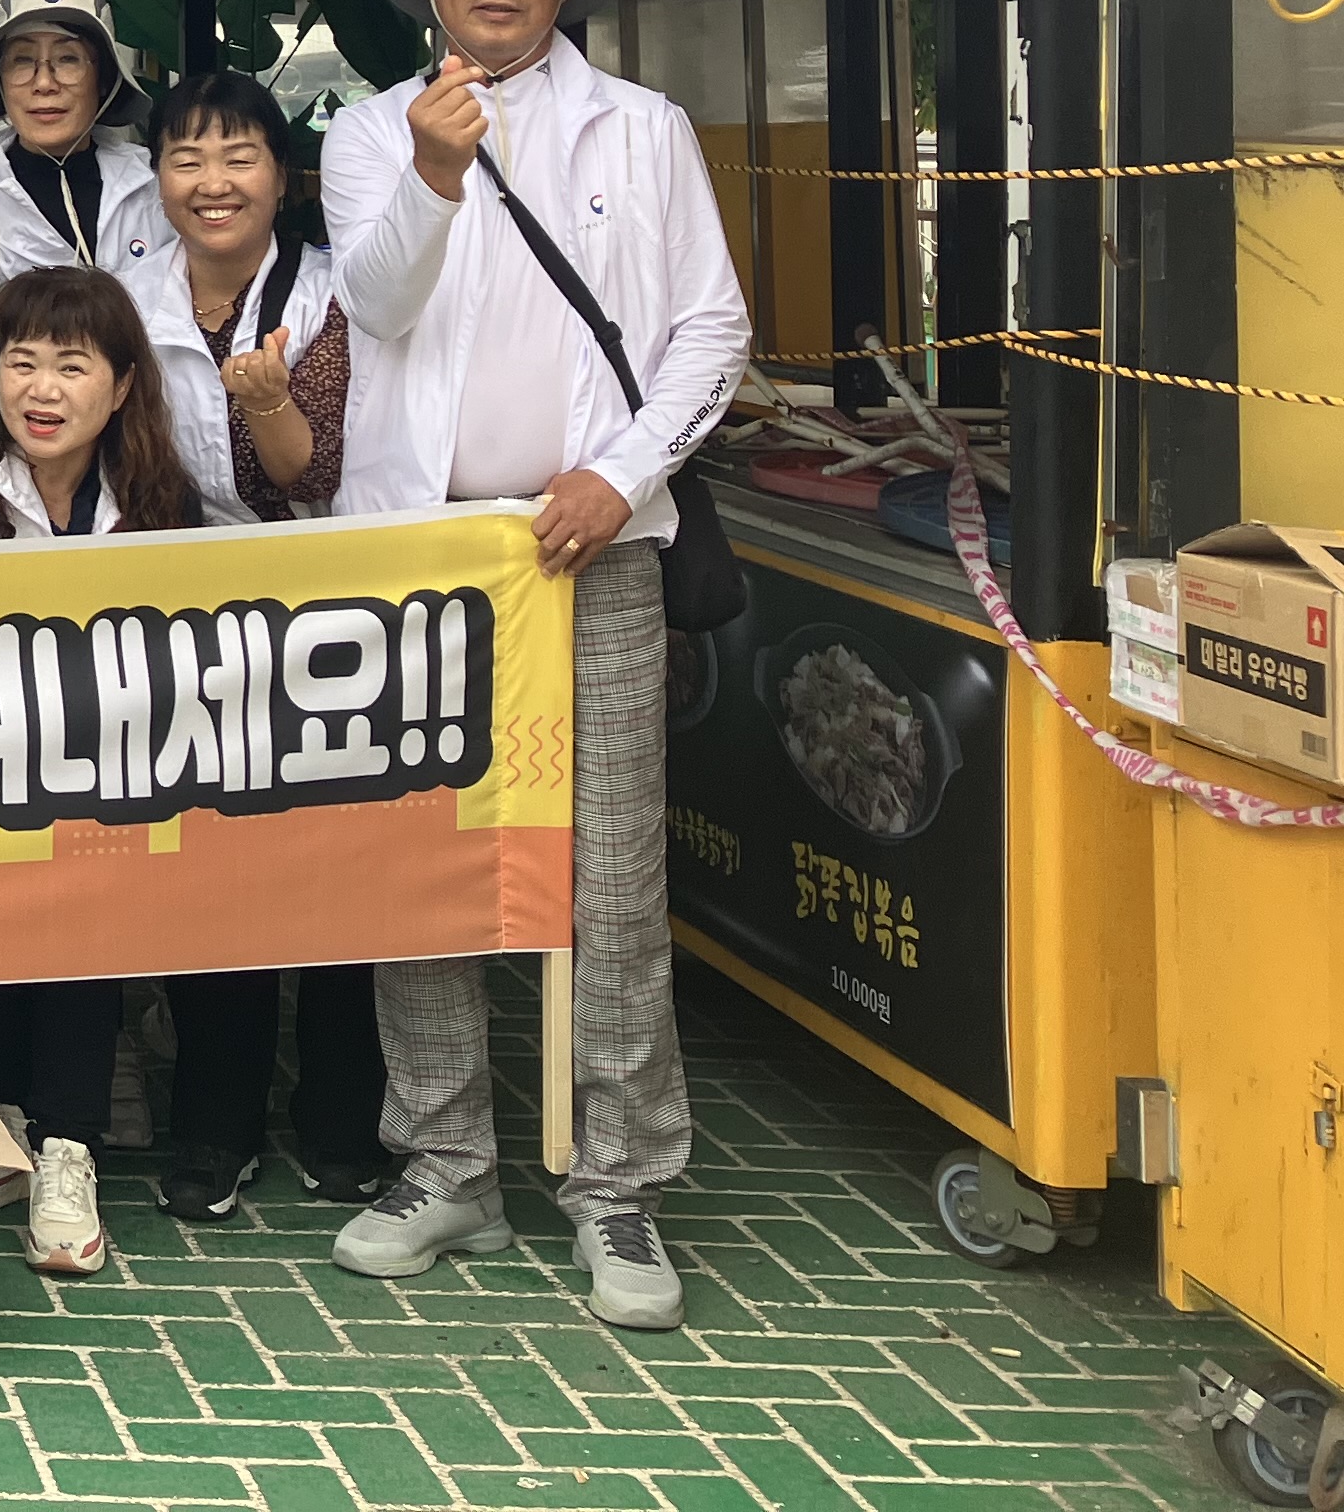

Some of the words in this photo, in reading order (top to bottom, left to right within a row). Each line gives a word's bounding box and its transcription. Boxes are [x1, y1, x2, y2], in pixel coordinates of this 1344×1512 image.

[667, 373, 728, 455] DOWNBLOW
[1200, 636, 1244, 681] 데일리
[1247, 652, 1310, 701] 우유식빵
[791, 840, 920, 969] 닭똥집볶음
[831, 965, 892, 1025] 10,000원
